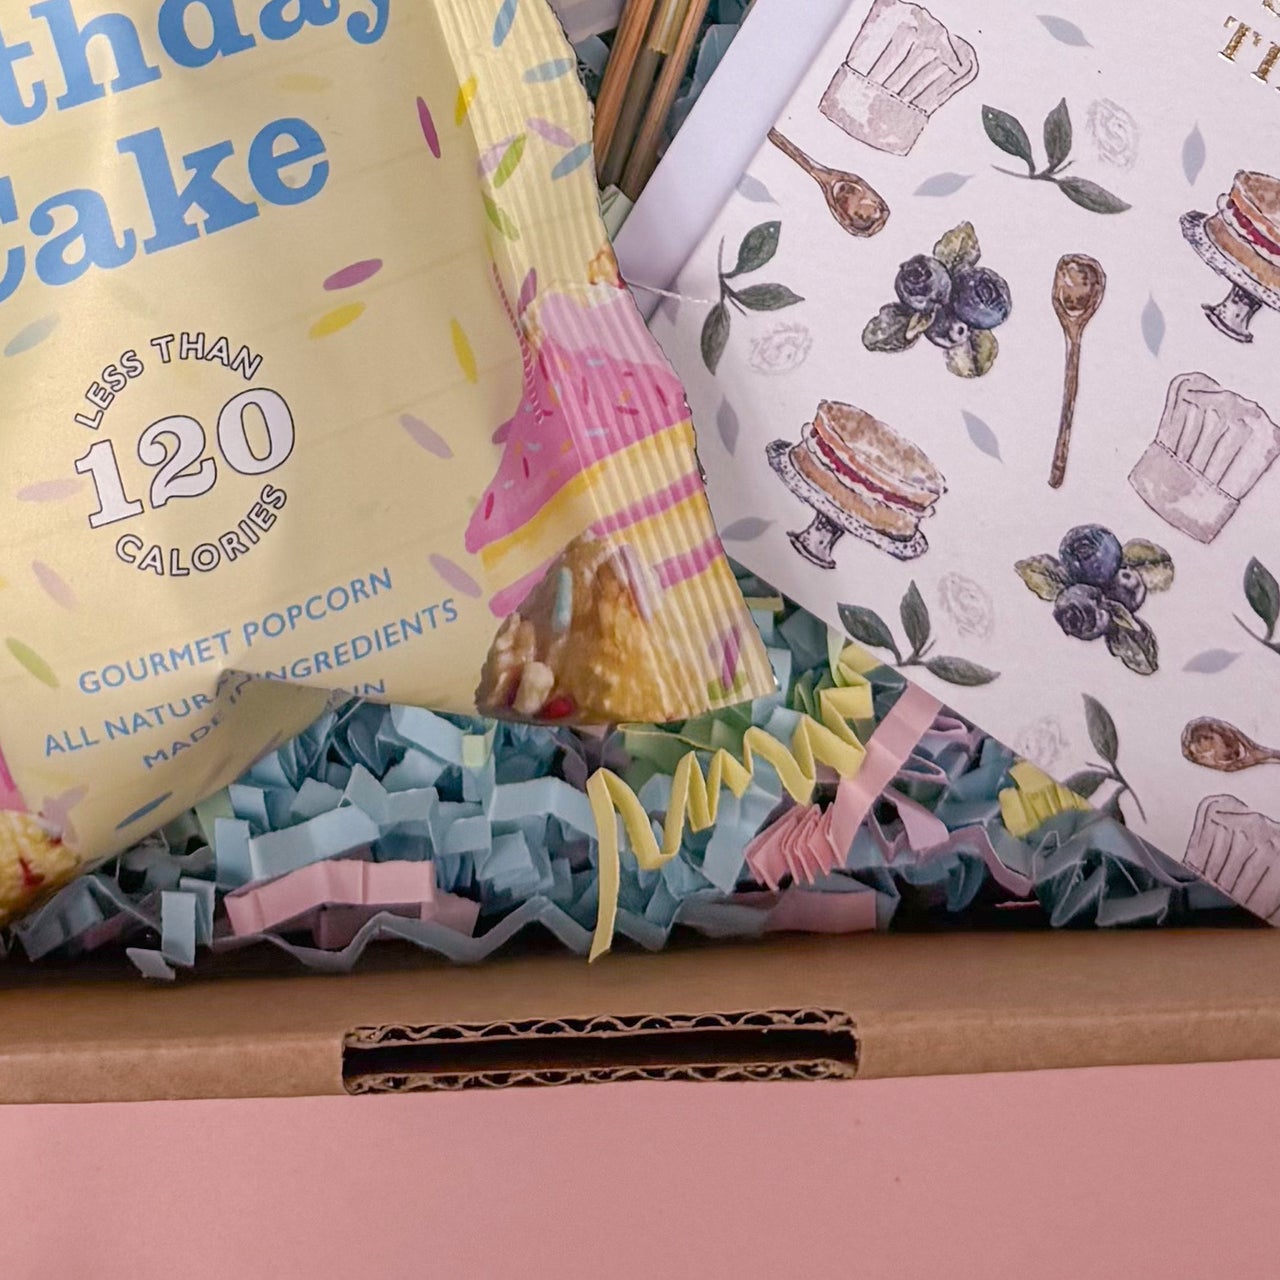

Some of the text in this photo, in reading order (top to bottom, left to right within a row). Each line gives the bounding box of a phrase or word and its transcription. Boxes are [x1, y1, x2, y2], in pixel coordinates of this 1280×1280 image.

[75, 332, 263, 430] LESS THAN
[74, 387, 296, 529] 120
[115, 483, 287, 576] CALORIES
[43, 727, 100, 756] ALL
[104, 671, 235, 739] NATUR
[256, 599, 459, 680] NGREDIENTS
[78, 631, 231, 694] GOURMET
[243, 567, 393, 647] POPCORN
